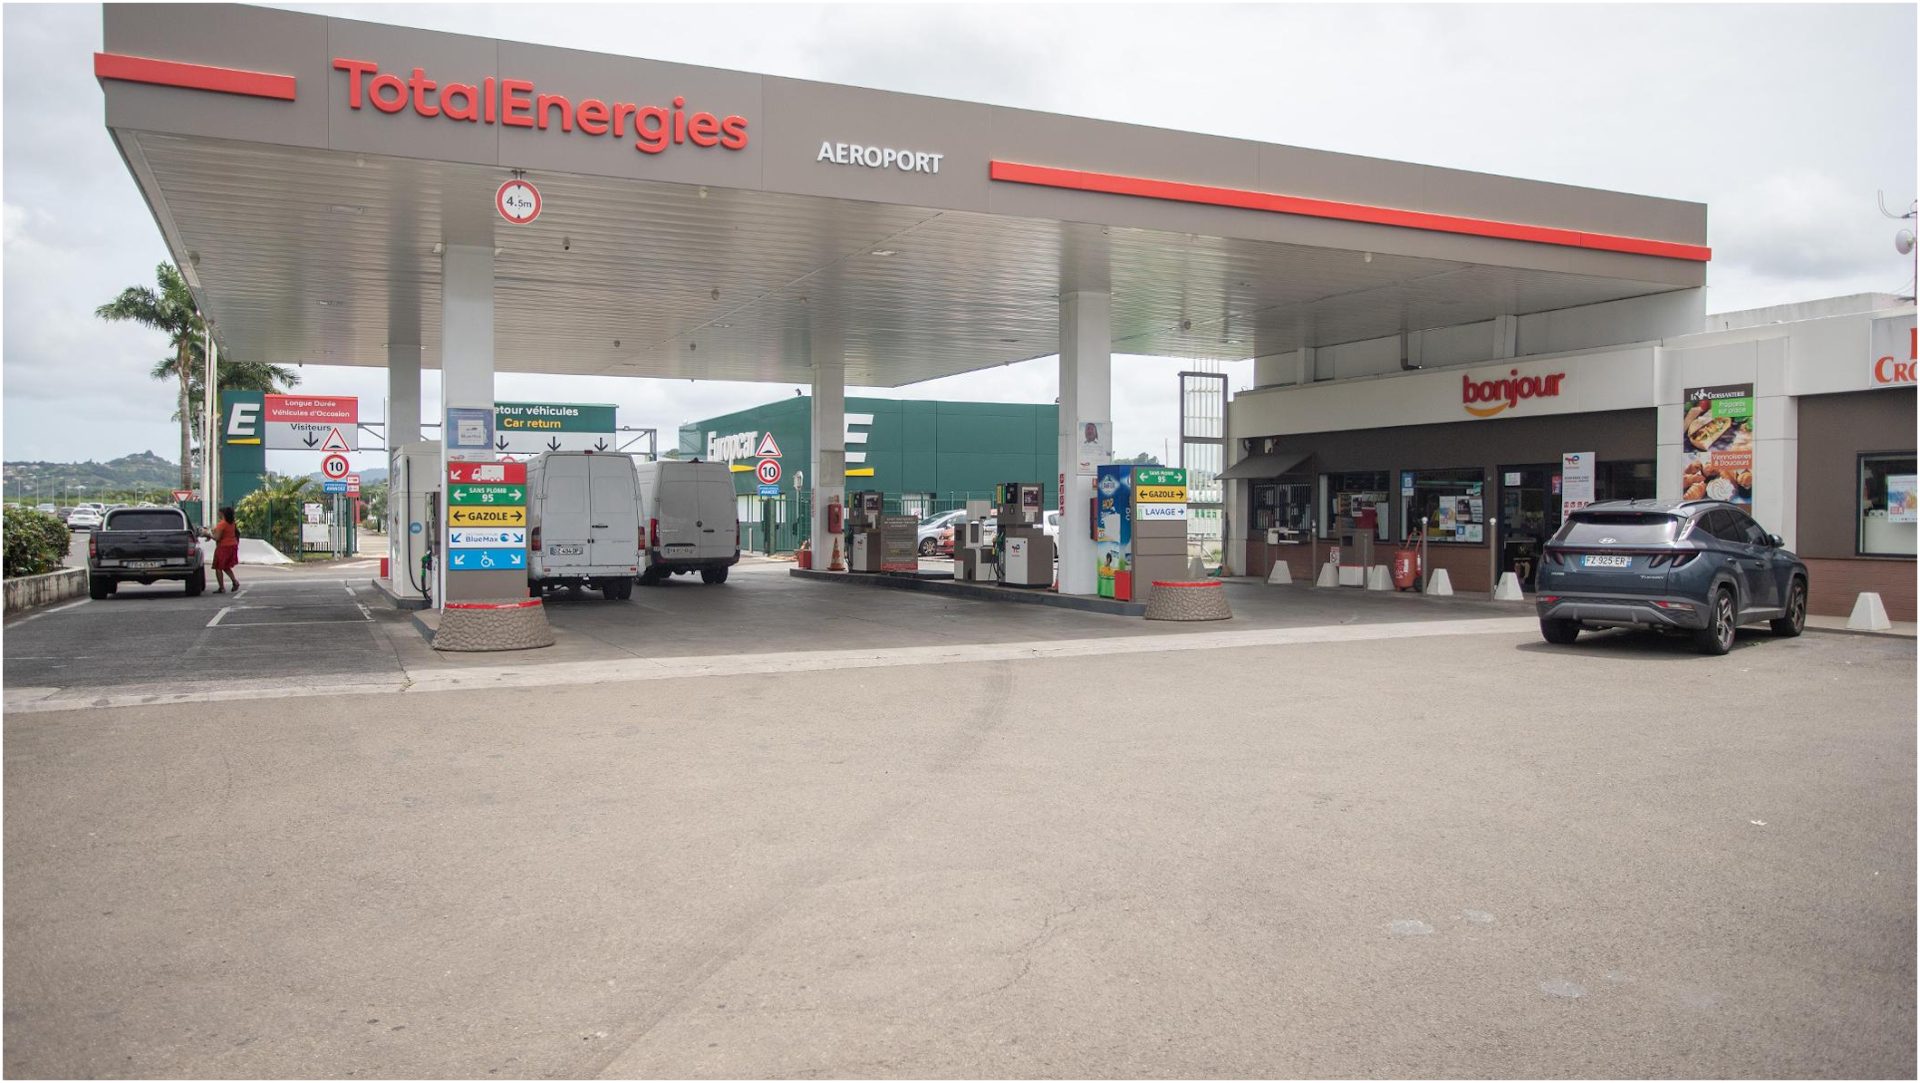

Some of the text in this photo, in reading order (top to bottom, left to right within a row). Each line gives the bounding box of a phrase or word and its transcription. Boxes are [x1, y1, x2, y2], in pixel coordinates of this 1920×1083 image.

[333, 59, 748, 154] TotalEnergies
[817, 141, 944, 174] AEROPORT
[507, 196, 532, 208] 4.5m
[1463, 369, 1565, 408] bonjour
[285, 400, 312, 408] Longue
[310, 410, 350, 418] d'Occasion
[495, 406, 523, 415] etour
[526, 406, 579, 416] véhicules
[227, 403, 260, 436] E
[503, 419, 562, 428] Car return
[290, 423, 331, 432] Visiteurs
[707, 431, 758, 467] Europcar
[329, 461, 343, 472] 10
[763, 467, 776, 478] 10
[482, 494, 494, 502] 95
[468, 512, 508, 521] GAZOLE
[1599, 557, 1612, 565] 925
[1616, 557, 1626, 565] ER
